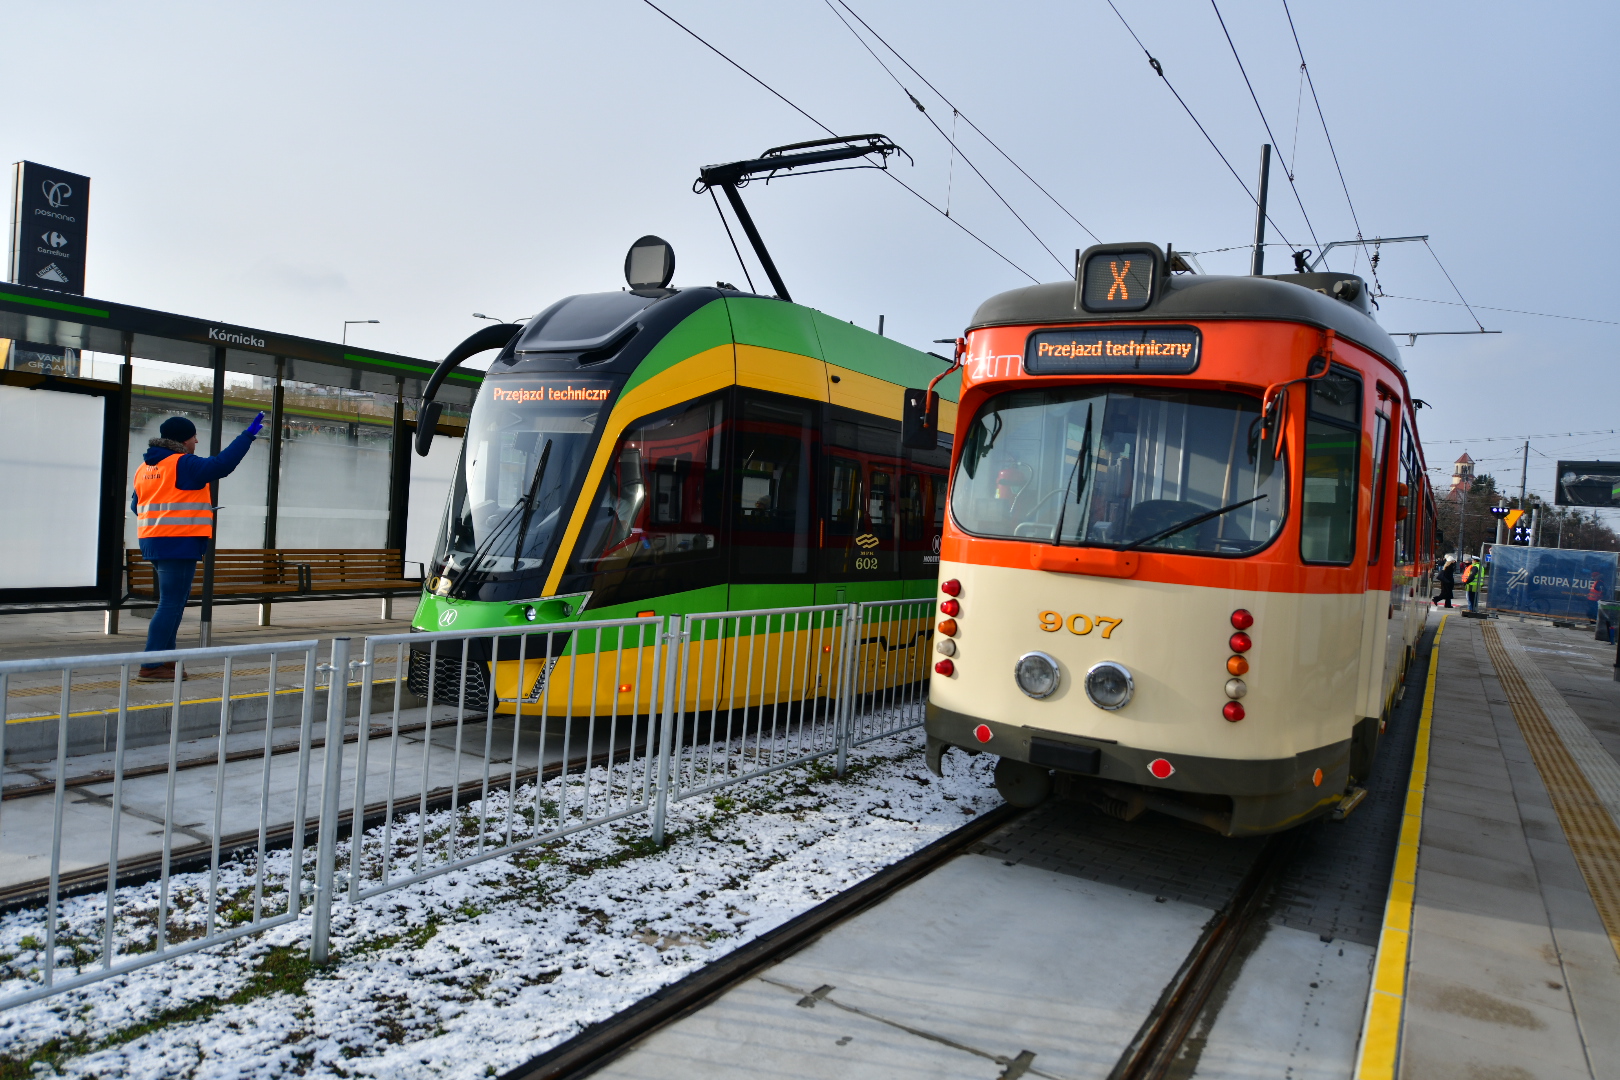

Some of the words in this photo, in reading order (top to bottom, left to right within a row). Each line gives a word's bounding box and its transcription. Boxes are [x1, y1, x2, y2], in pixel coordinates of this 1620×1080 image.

[35, 208, 75, 222] posnania
[37, 247, 69, 258] Carrefour
[36, 262, 54, 277] LEROY
[1107, 260, 1131, 301] X
[208, 327, 265, 348] Kórnicka
[1038, 340, 1102, 359] Przejazd
[1105, 340, 1192, 358] techniczny
[37, 353, 61, 362] VAN
[493, 386, 545, 404] Przejazd
[856, 558, 878, 569] 602
[1532, 575, 1570, 588] GRUPA
[1571, 578, 1596, 590] ZUE
[1038, 610, 1123, 639] 907
